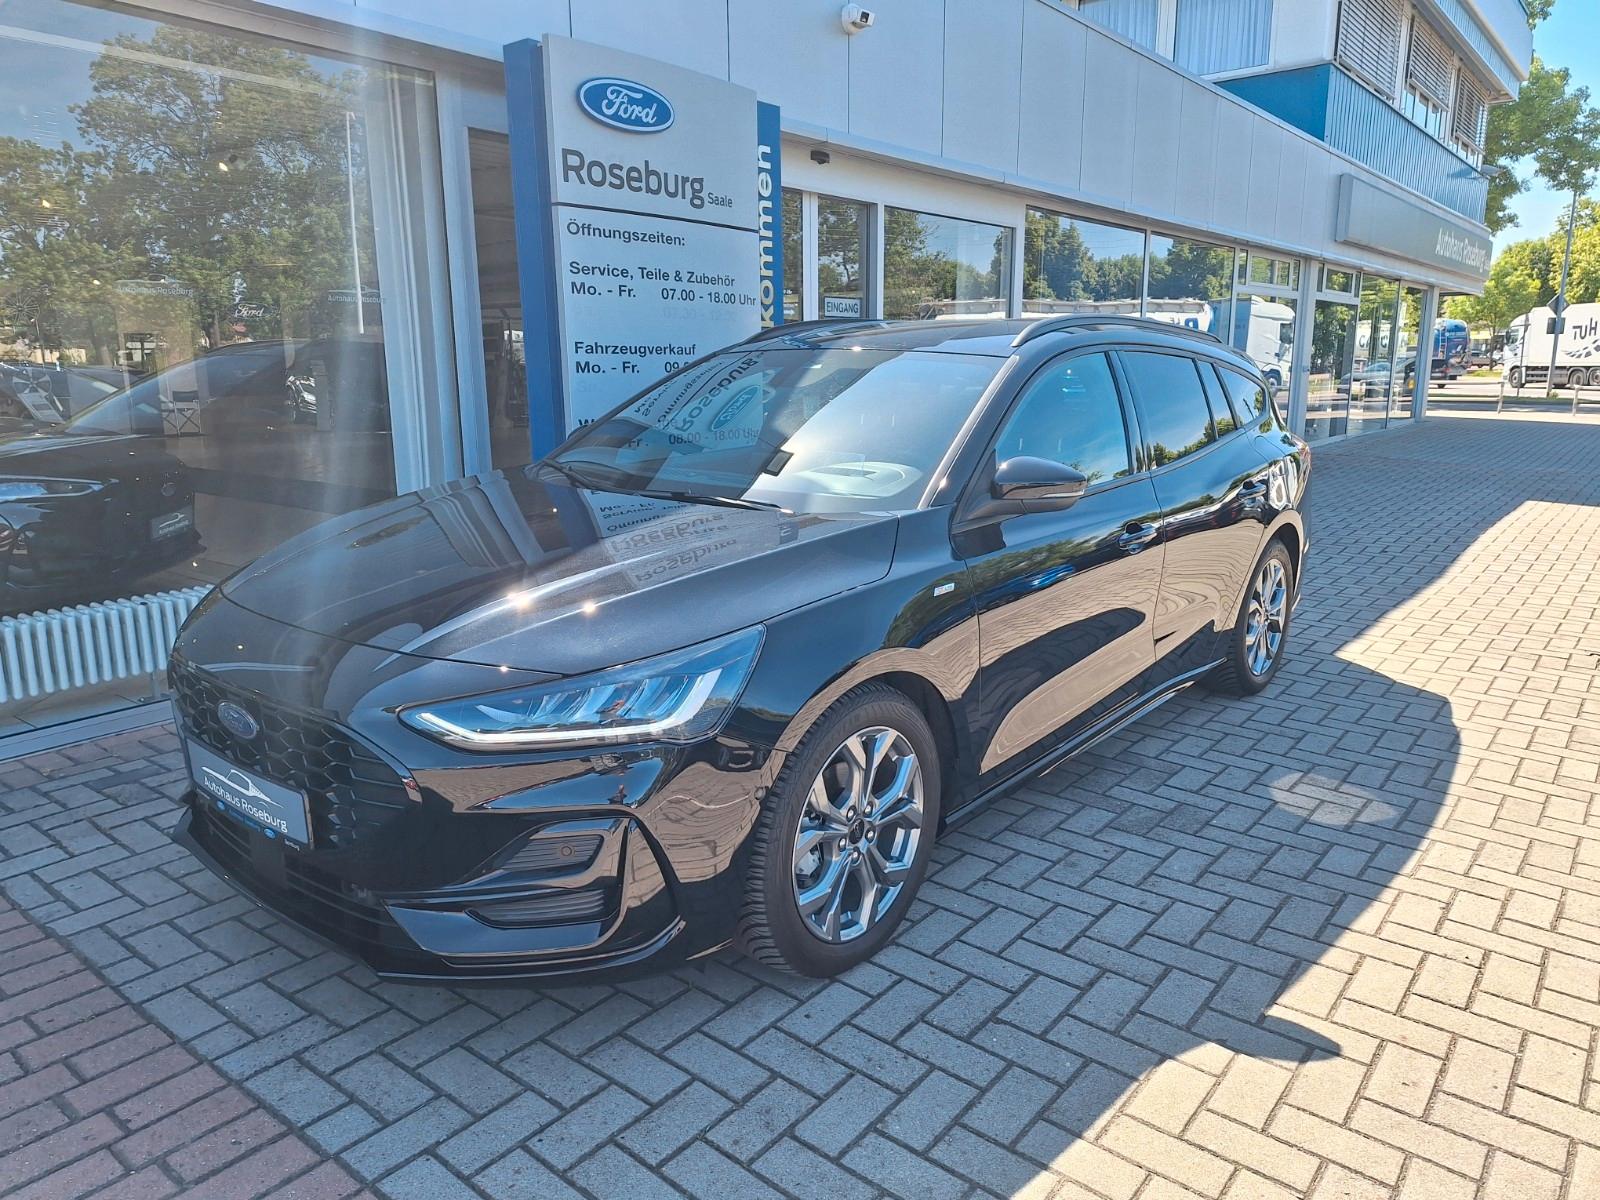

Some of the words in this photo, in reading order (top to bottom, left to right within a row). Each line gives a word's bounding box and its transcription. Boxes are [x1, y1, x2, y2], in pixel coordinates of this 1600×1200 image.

[602, 86, 657, 124] Ford
[561, 148, 705, 209] Roseburg
[707, 193, 733, 208] Saale
[566, 218, 686, 246] Öffnungszeiten:
[569, 261, 634, 281] Service,
[638, 266, 670, 281] Teile
[674, 270, 683, 282] &
[687, 271, 735, 287] Zubehör
[571, 281, 602, 296] Mo.
[618, 284, 636, 298] Fr.
[661, 288, 695, 302] 07.00
[708, 292, 736, 304] 18.00
[738, 295, 756, 306] Uhr
[826, 301, 859, 314] EINGANG
[574, 341, 697, 358] Fahrzeugverkauf
[575, 361, 606, 374] Mo.
[622, 362, 640, 374] Fr.
[204, 775, 241, 807] Autohaus
[241, 798, 288, 833] Roseburg
